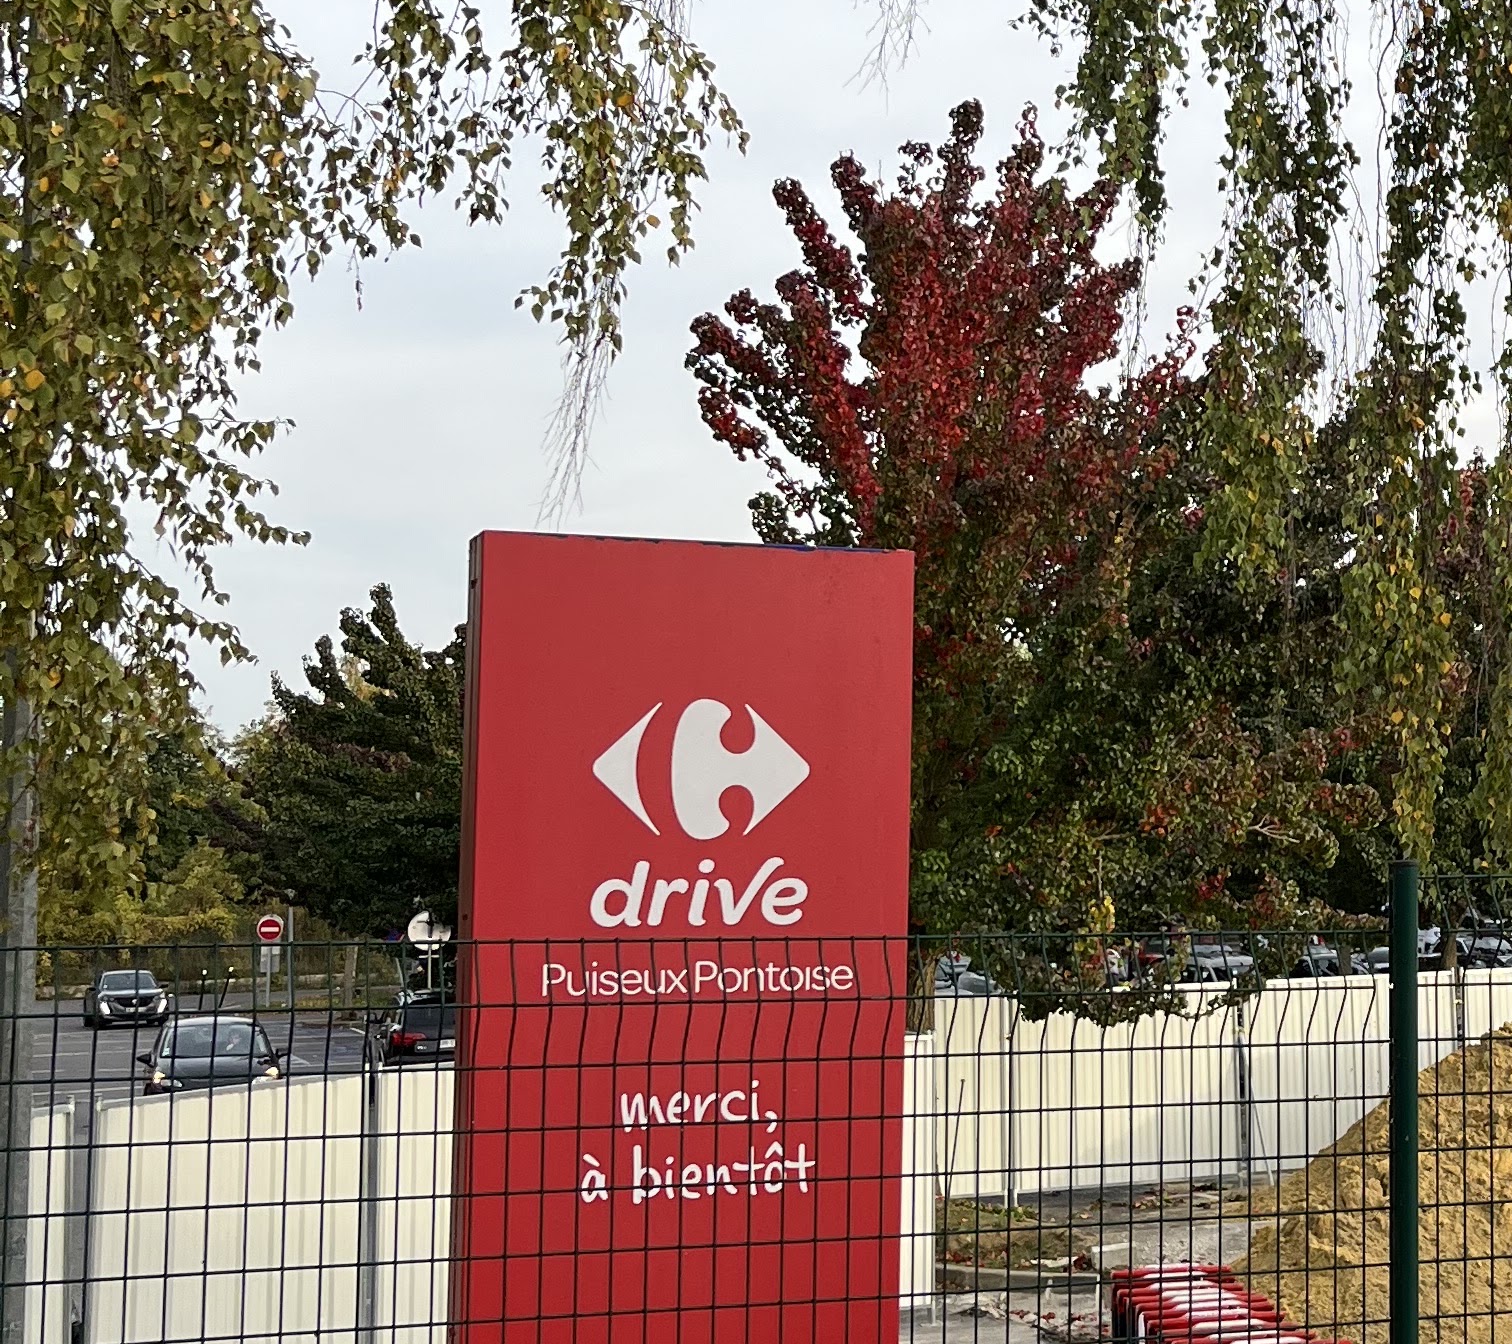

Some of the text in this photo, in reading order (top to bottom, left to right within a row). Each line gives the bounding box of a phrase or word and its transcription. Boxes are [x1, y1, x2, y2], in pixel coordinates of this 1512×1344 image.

[589, 856, 809, 928] drive
[541, 960, 854, 997] Puiseux Pontoise
[620, 1079, 779, 1133] merci,
[580, 1140, 816, 1205] à bientôt
